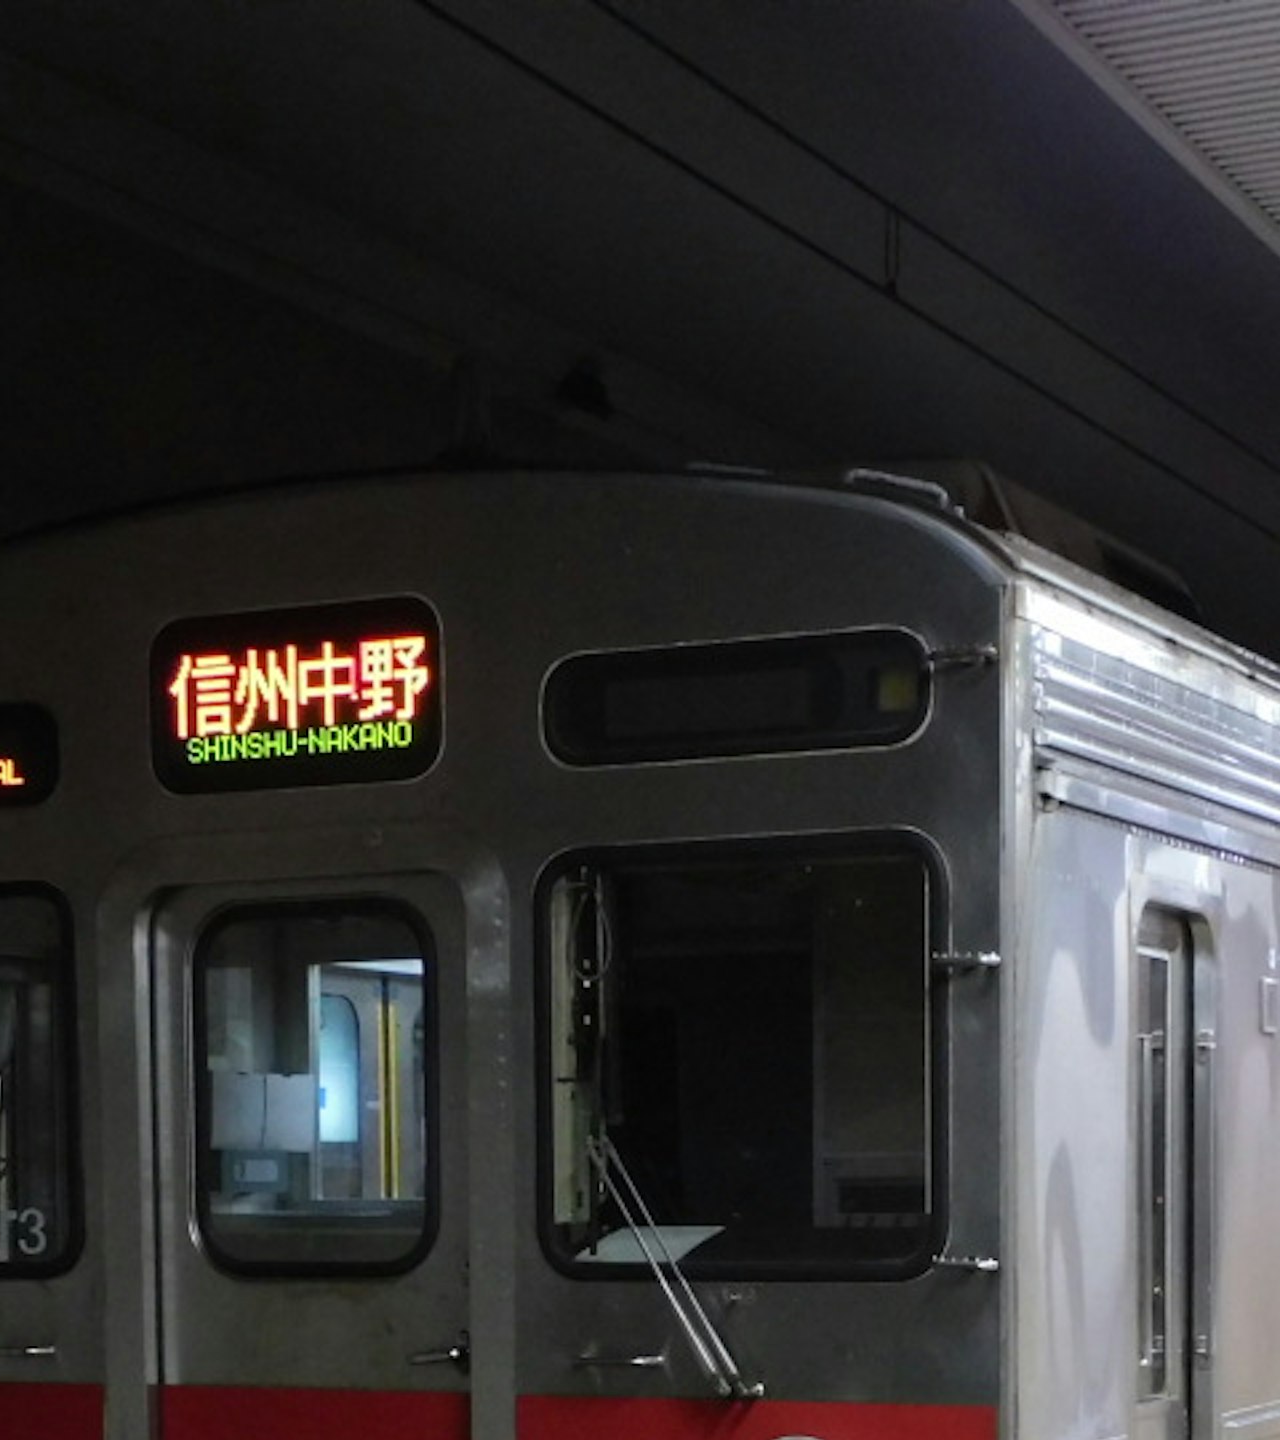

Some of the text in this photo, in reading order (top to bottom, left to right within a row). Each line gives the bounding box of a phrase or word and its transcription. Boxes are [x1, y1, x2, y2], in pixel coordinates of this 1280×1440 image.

[169, 635, 429, 739] 信州中野
[187, 721, 412, 764] SHINSHU-NAKANO
